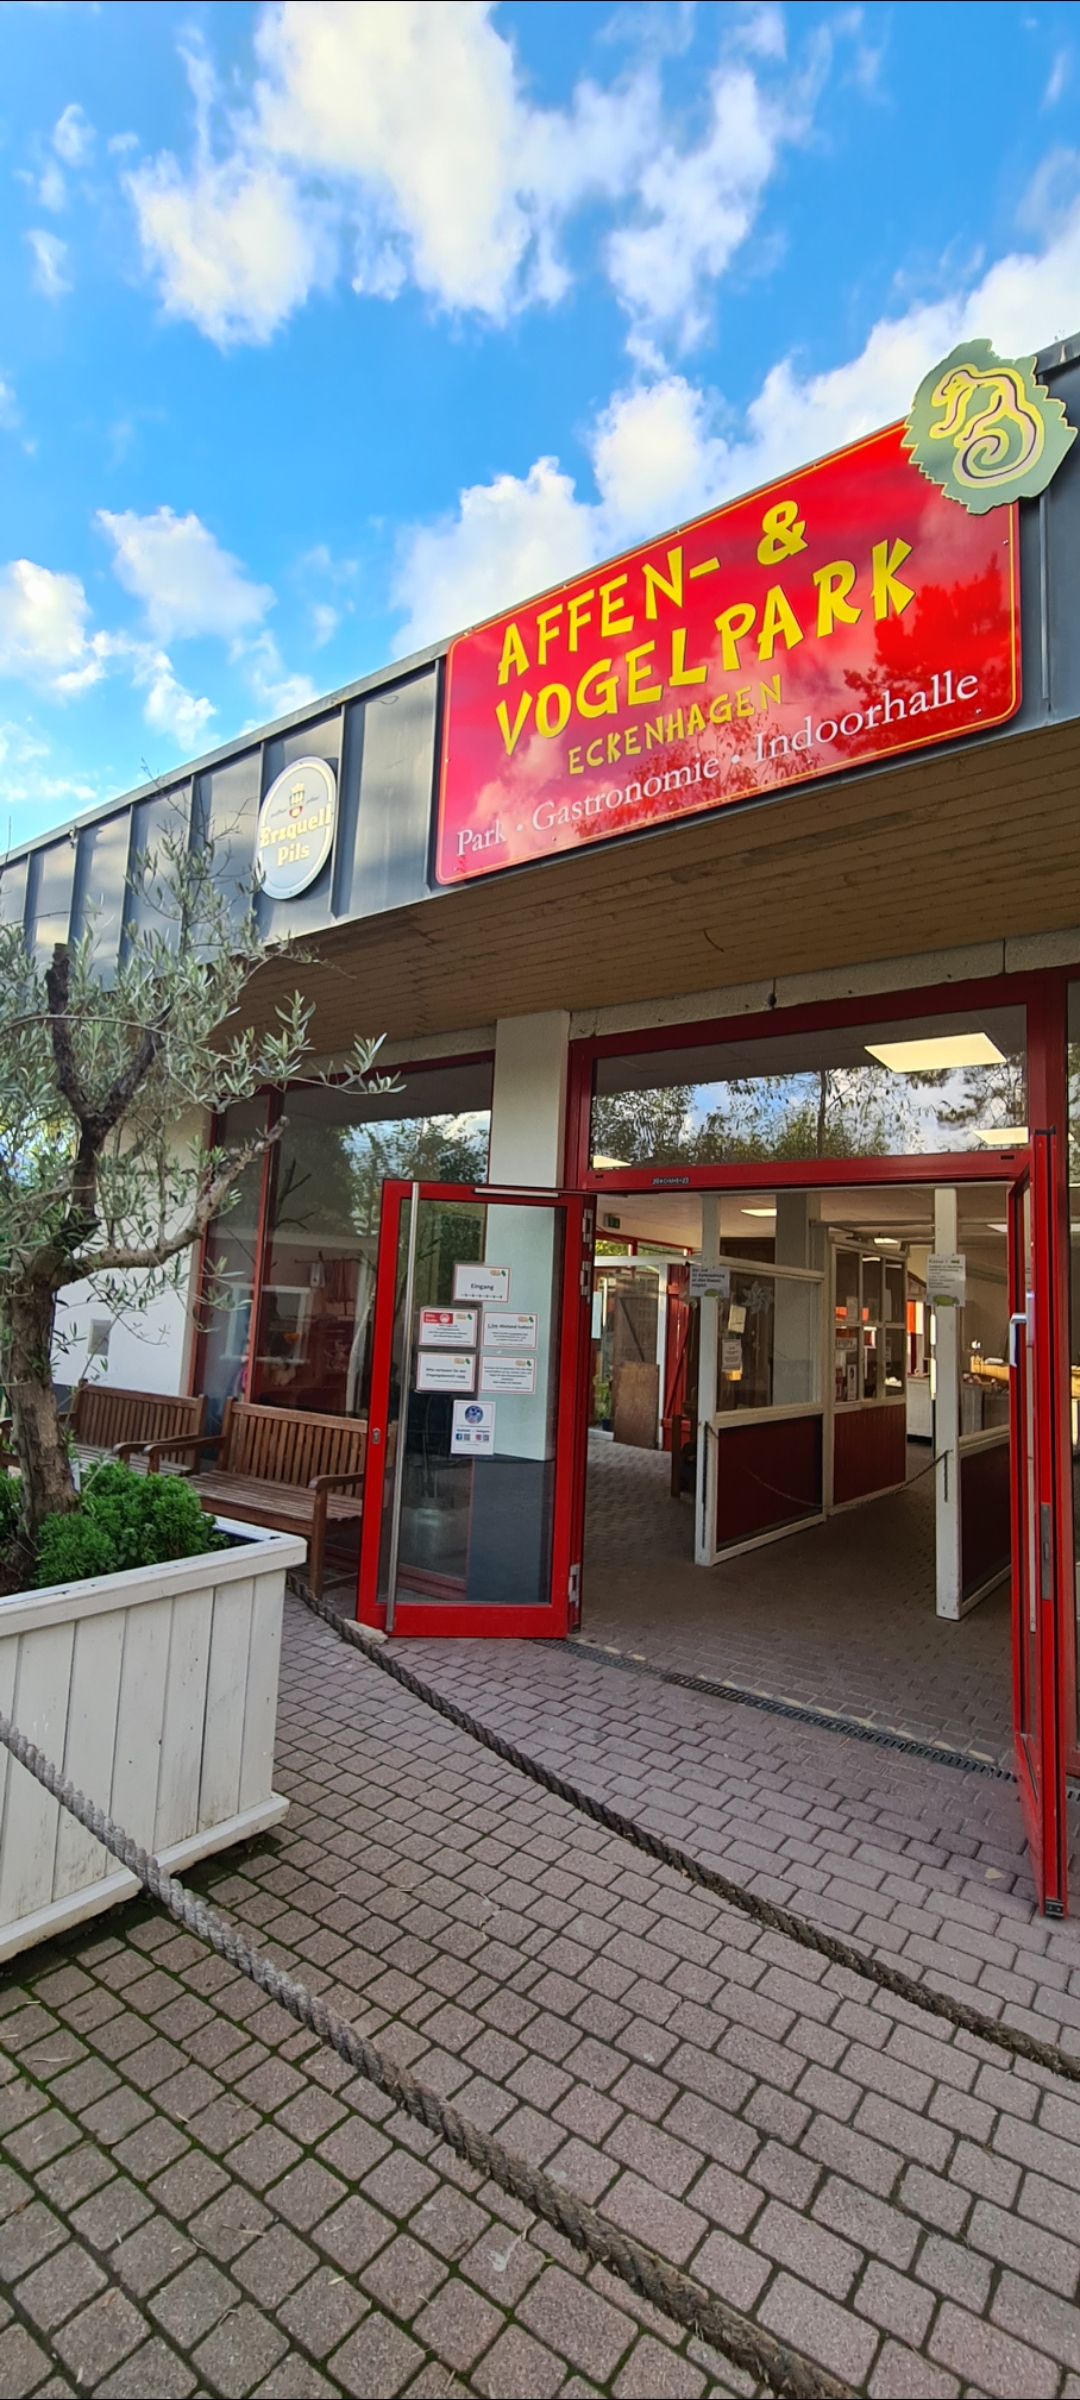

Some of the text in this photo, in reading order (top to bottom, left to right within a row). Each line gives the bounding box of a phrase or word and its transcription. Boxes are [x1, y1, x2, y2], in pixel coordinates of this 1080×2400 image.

[498, 500, 809, 686] AFFEN- &
[495, 537, 917, 756] VOGELPARK
[456, 669, 979, 857] Park Gastronomie Indoorhalle
[567, 673, 782, 775] ECKENHAGEN
[259, 803, 332, 848] Erzquell
[276, 841, 311, 867] Pils
[470, 1283, 494, 1291] Eingang
